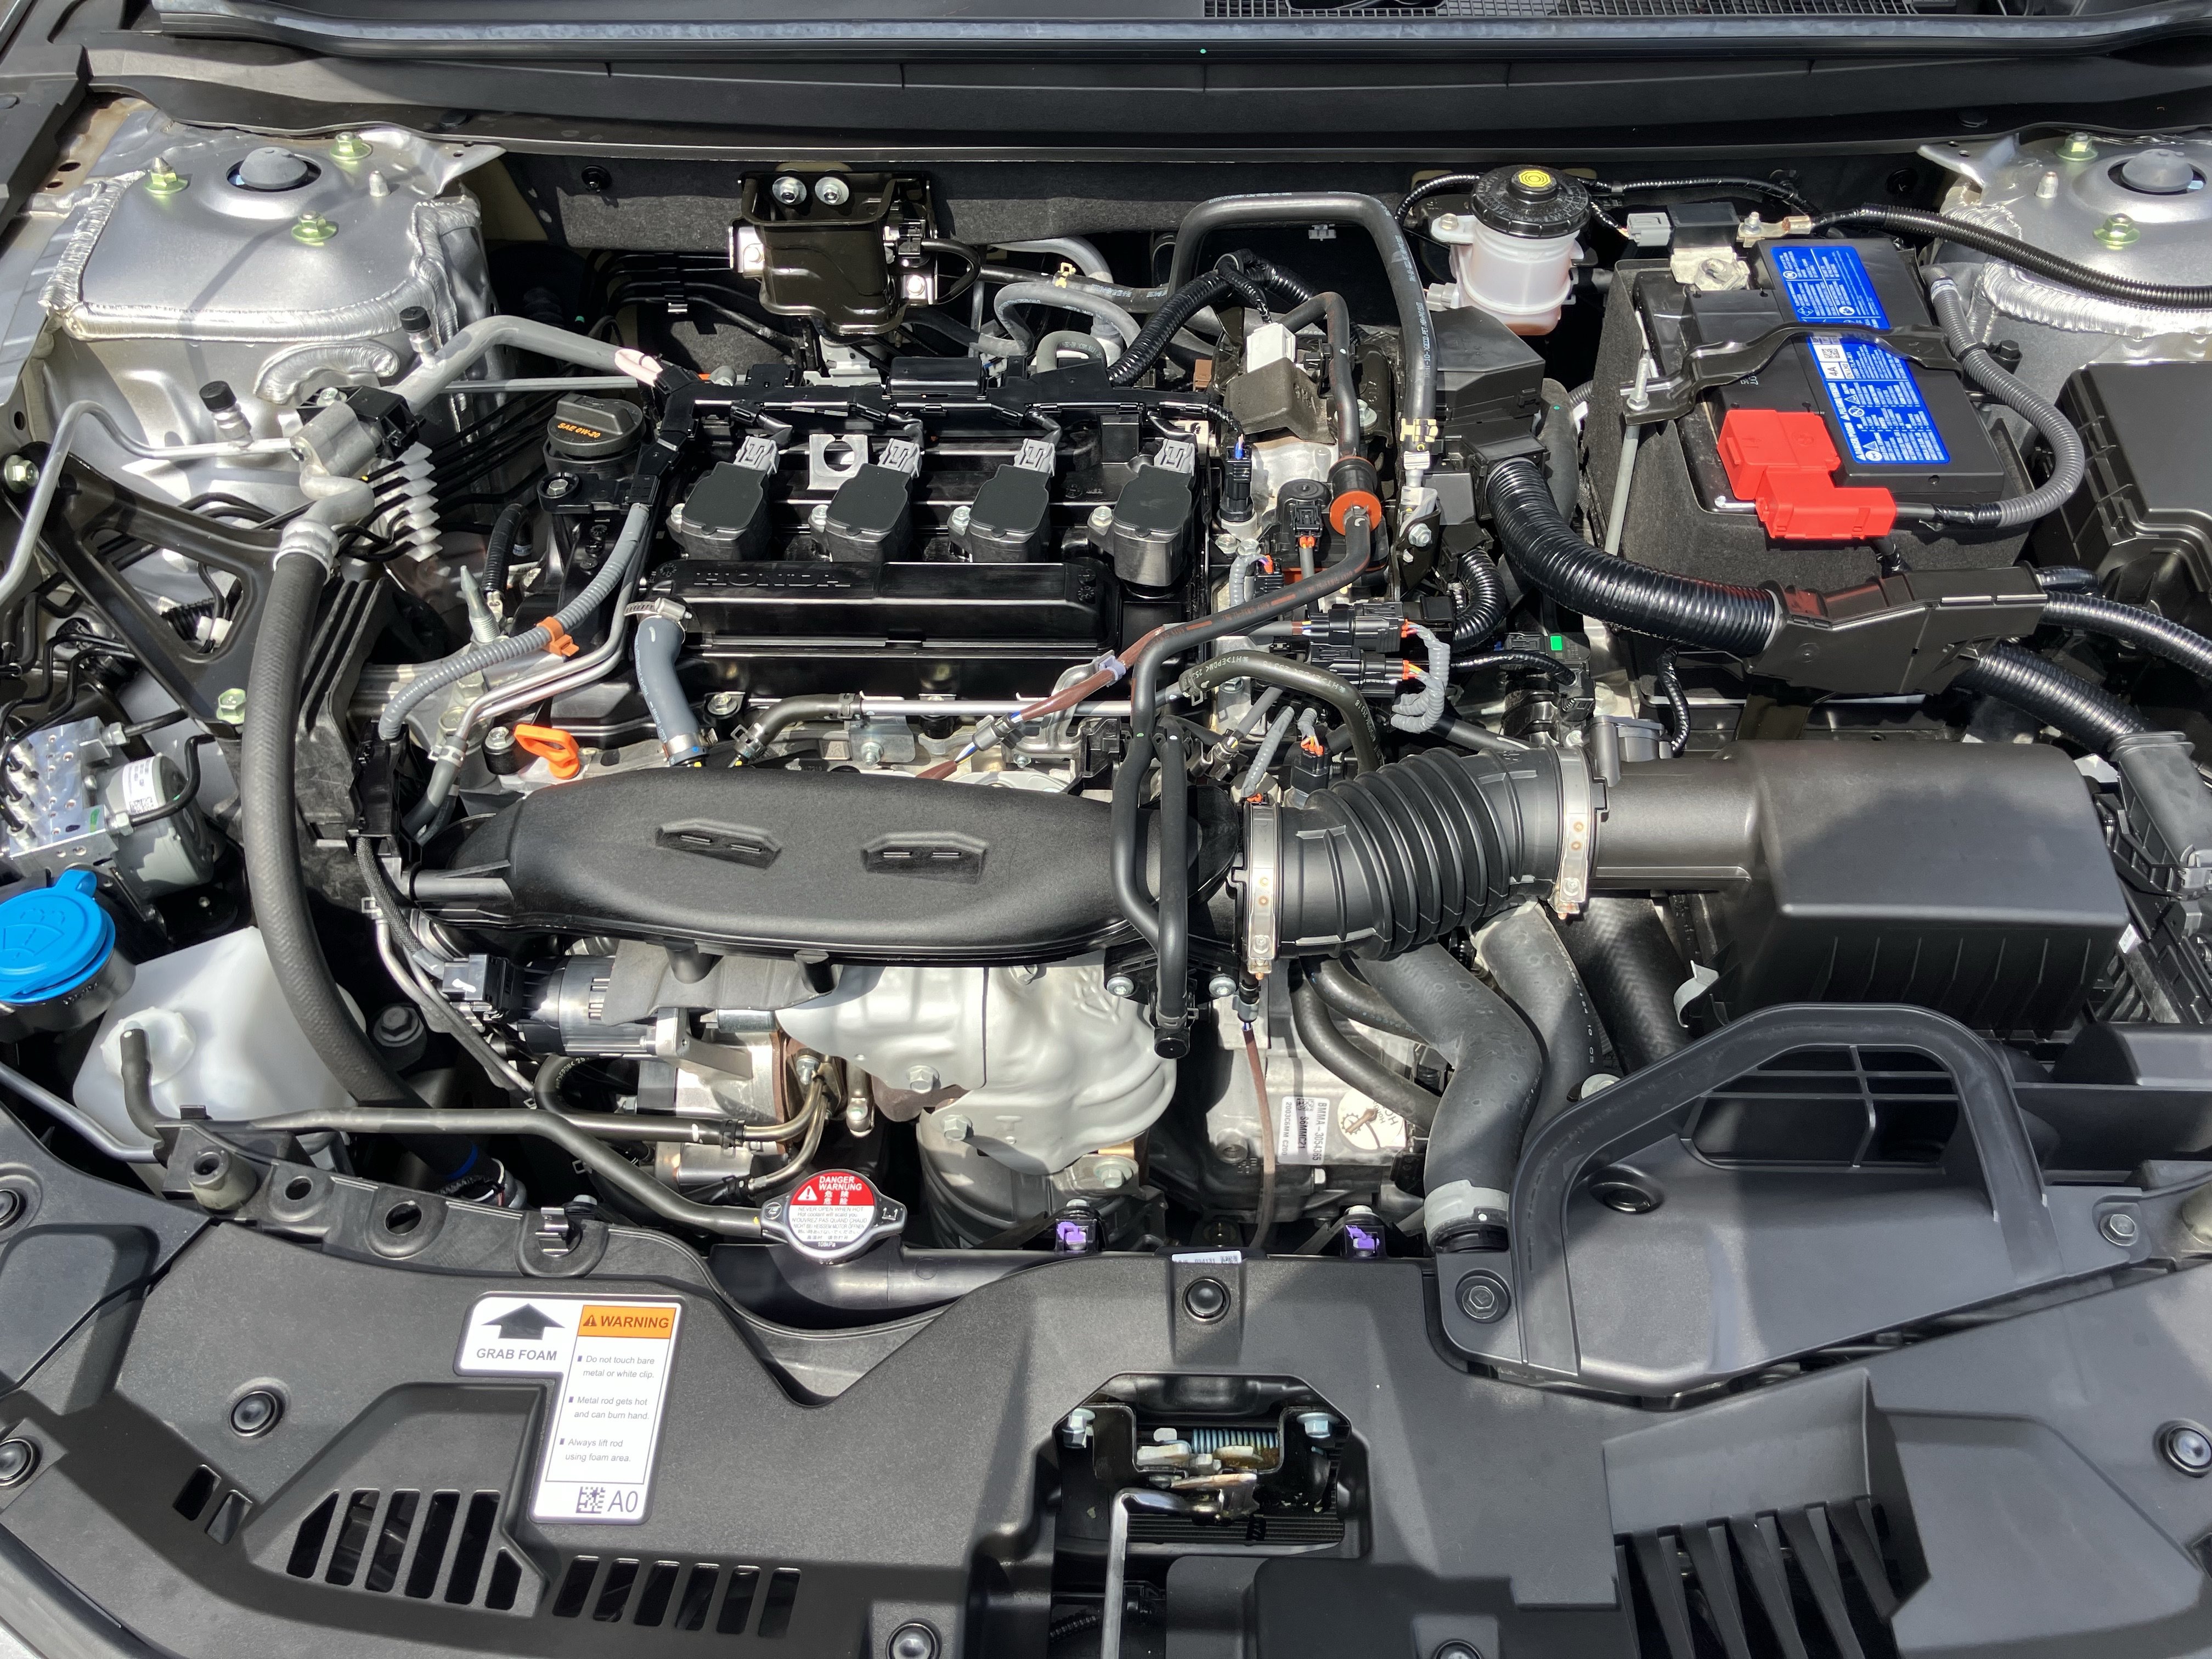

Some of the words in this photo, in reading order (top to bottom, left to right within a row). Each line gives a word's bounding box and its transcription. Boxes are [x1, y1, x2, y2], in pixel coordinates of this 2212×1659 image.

[1826, 366, 1839, 376] 4A
[557, 422, 577, 431] SAE
[575, 427, 601, 438] 0W-20
[693, 572, 851, 588] HONDA
[1298, 1116, 1308, 1149] S6MMC21
[600, 1315, 669, 1328] WARNING
[476, 1348, 515, 1359] GRAB
[518, 1350, 557, 1361] FOAM
[639, 1371, 654, 1379] clip.
[568, 1438, 596, 1448] Always
[565, 1453, 586, 1463] using
[589, 1453, 608, 1462] foam
[607, 1490, 639, 1513] A0
